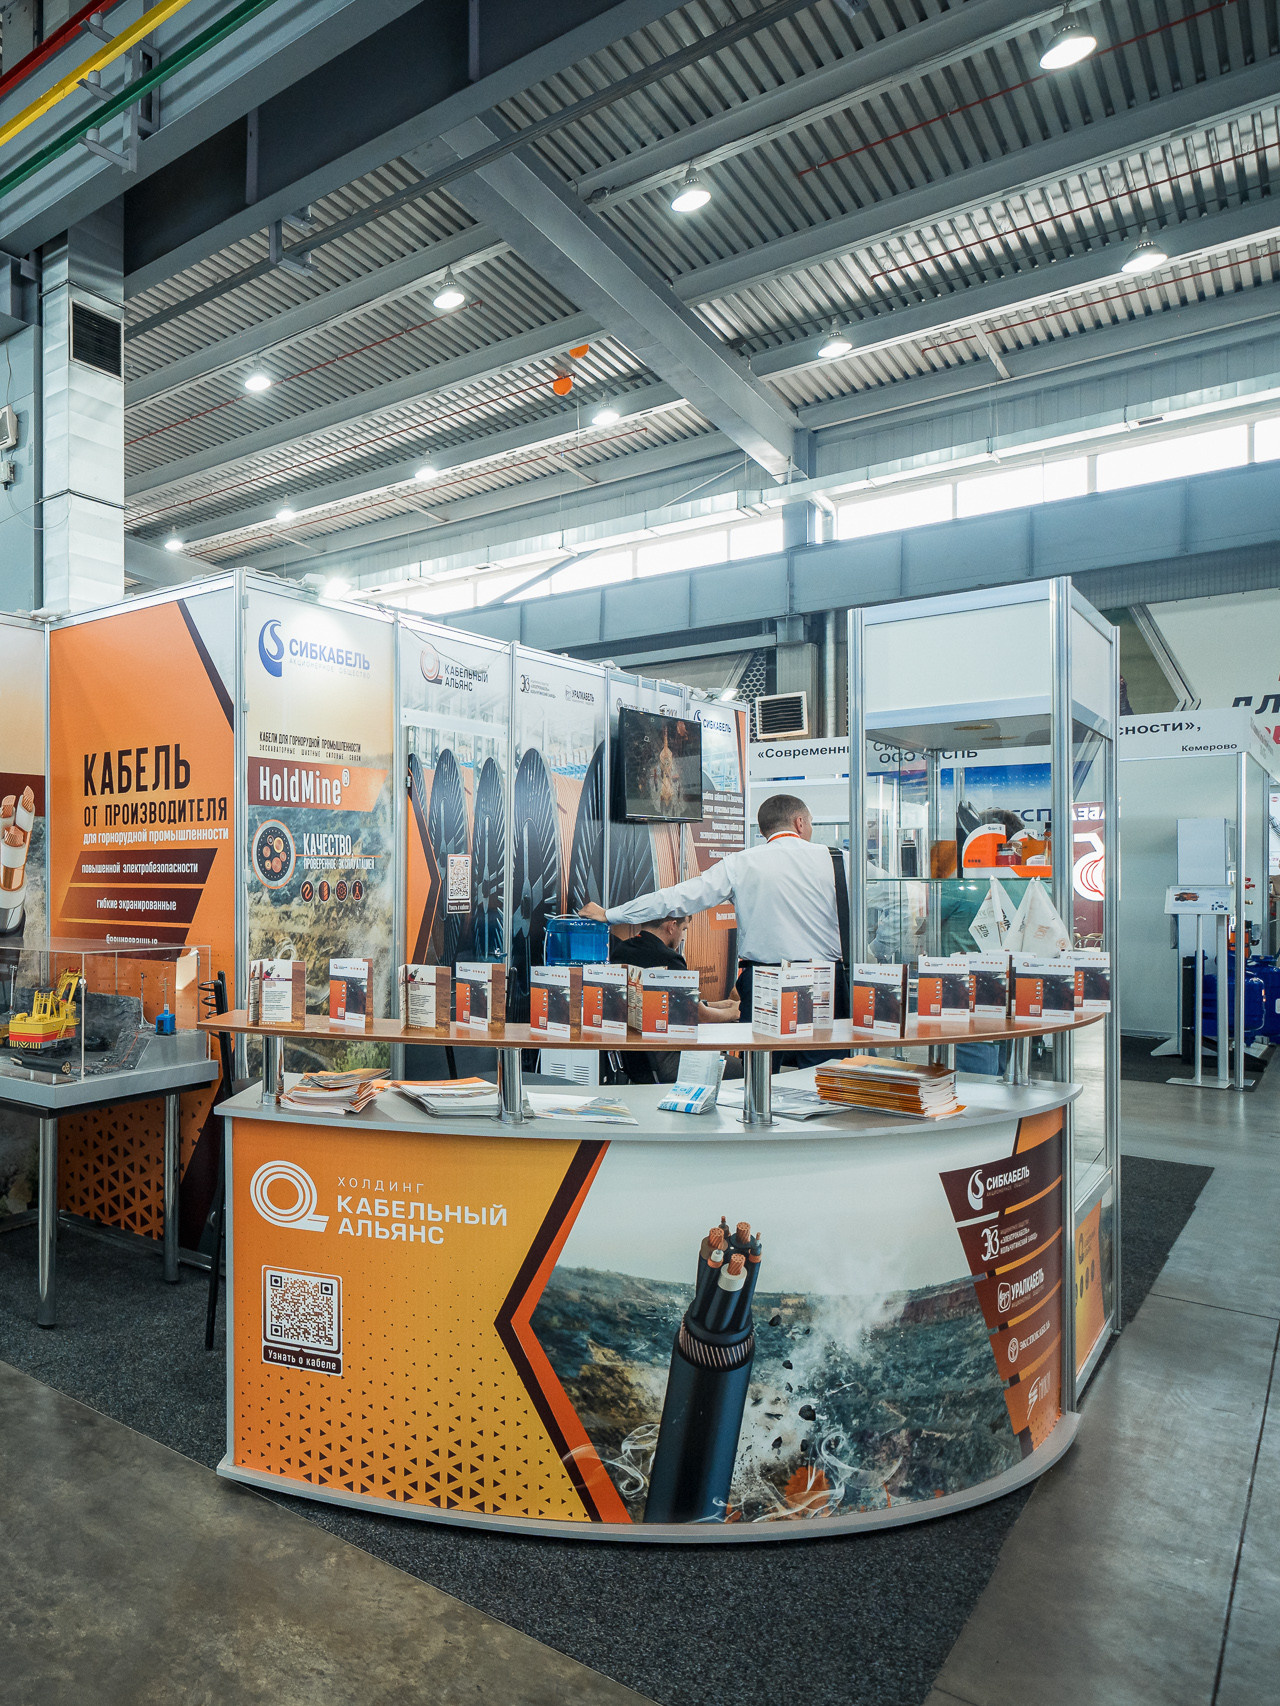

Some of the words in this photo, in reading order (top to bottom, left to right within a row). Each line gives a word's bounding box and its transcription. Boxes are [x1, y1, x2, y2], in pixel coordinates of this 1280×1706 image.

[289, 638, 371, 671] СИБКАБЕЛЬ
[444, 676, 473, 692] АЛЬЯНС
[703, 718, 732, 733] СИБКАБЕЛЬ
[1181, 743, 1237, 751] Кемерово
[83, 743, 191, 797] КАБЕЛЬ
[259, 766, 350, 806] HoldMine®
[84, 805, 98, 827] ОТ
[104, 797, 228, 826] ПРОИЗВОДИТЕЛЯ
[83, 833, 97, 845] для
[98, 829, 147, 846] горнорудной
[149, 827, 229, 844] промышленности
[81, 862, 121, 873] повышенной
[122, 861, 199, 875] электробезопасности
[96, 898, 118, 909] гибкие
[119, 900, 177, 912] экранированные
[337, 1177, 424, 1194] ХОЛДИНГ
[986, 1165, 1030, 1191] СИБКАБЕЛЬ
[337, 1195, 508, 1227] КАБЕЛЬНЫЙ
[337, 1217, 444, 1245] АЛЬЯНС
[1011, 1267, 1045, 1300] УРАЛКАБЕЛЬ
[268, 1349, 296, 1363] Узнать
[298, 1357, 303, 1365] о
[306, 1358, 337, 1370] кабеле
